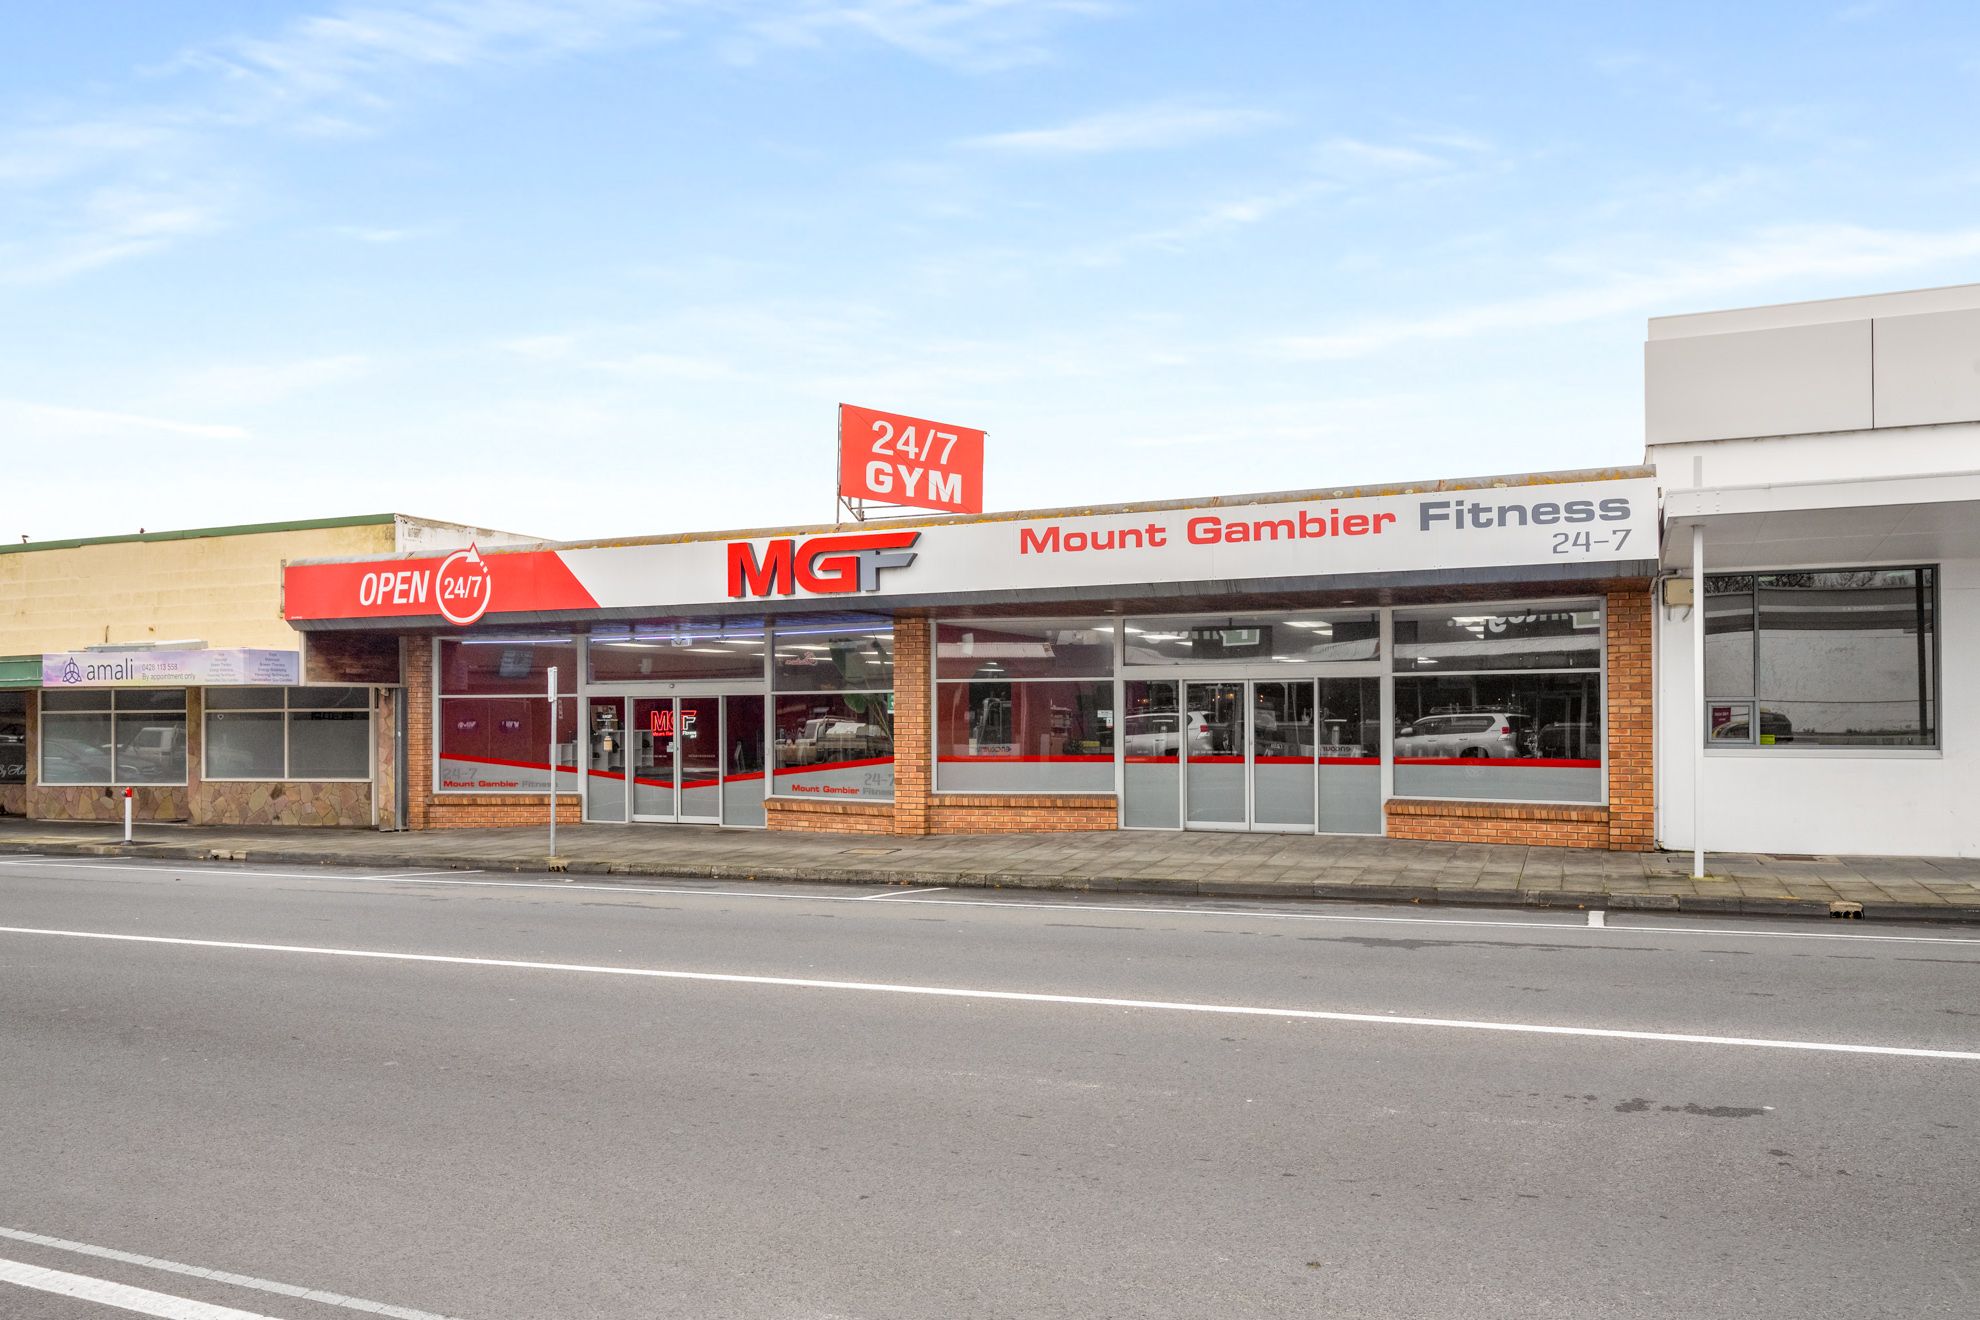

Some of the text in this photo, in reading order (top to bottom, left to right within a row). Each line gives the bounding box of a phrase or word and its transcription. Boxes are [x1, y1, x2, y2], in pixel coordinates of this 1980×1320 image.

[872, 420, 958, 465] 24/7
[866, 460, 962, 504] GYM
[1020, 498, 1631, 555] Mount Gambier Fitness
[1552, 529, 1632, 554] 24-7
[359, 570, 482, 606] OPEN 24/7
[86, 658, 134, 681] amali
[792, 784, 820, 792] Mount
[823, 785, 859, 794] Gambier
